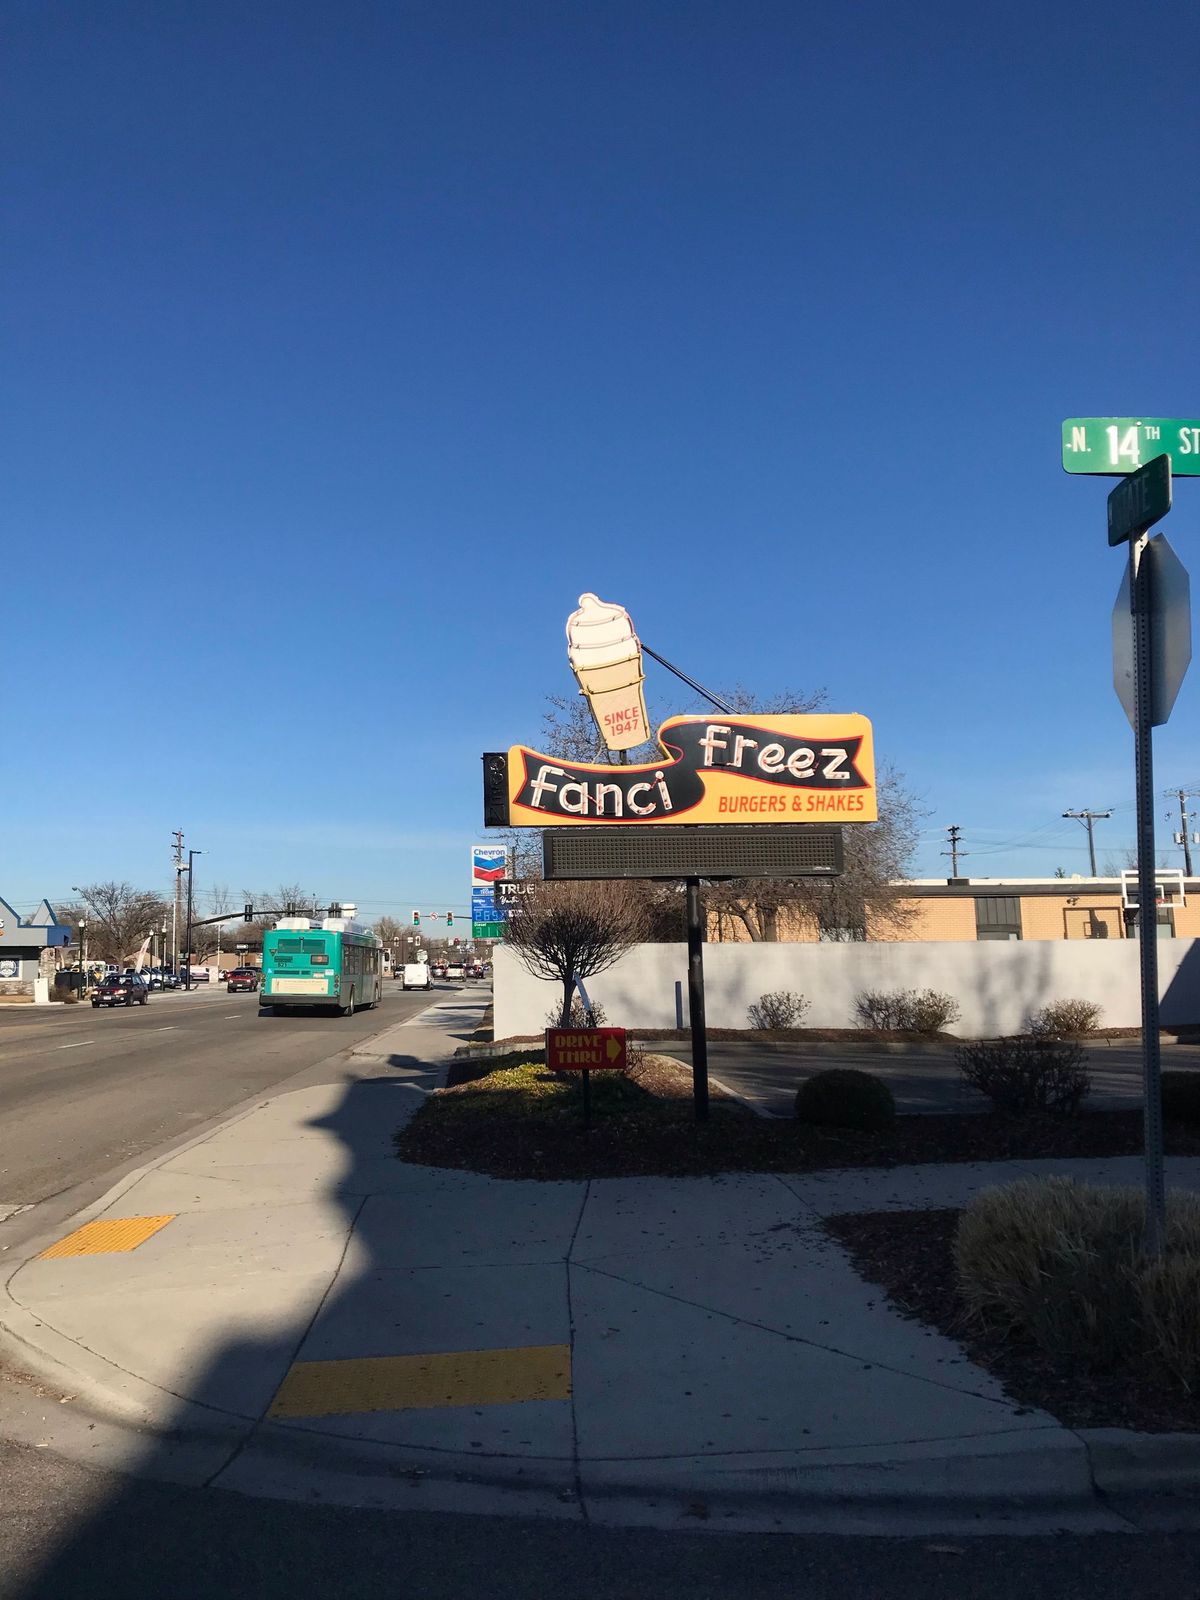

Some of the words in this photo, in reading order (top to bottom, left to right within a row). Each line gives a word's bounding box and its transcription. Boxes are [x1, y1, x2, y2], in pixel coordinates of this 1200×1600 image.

[1072, 426, 1092, 452] N.
[604, 706, 640, 726] SINCE
[611, 719, 639, 737] 1947
[718, 795, 787, 813] BURGERS
[791, 795, 803, 811] &
[807, 794, 864, 812] SHAKES
[473, 848, 505, 856] Chevron
[499, 883, 535, 895] TRUE
[555, 1035, 602, 1048] DRIVE
[558, 1050, 602, 1063] THRU
